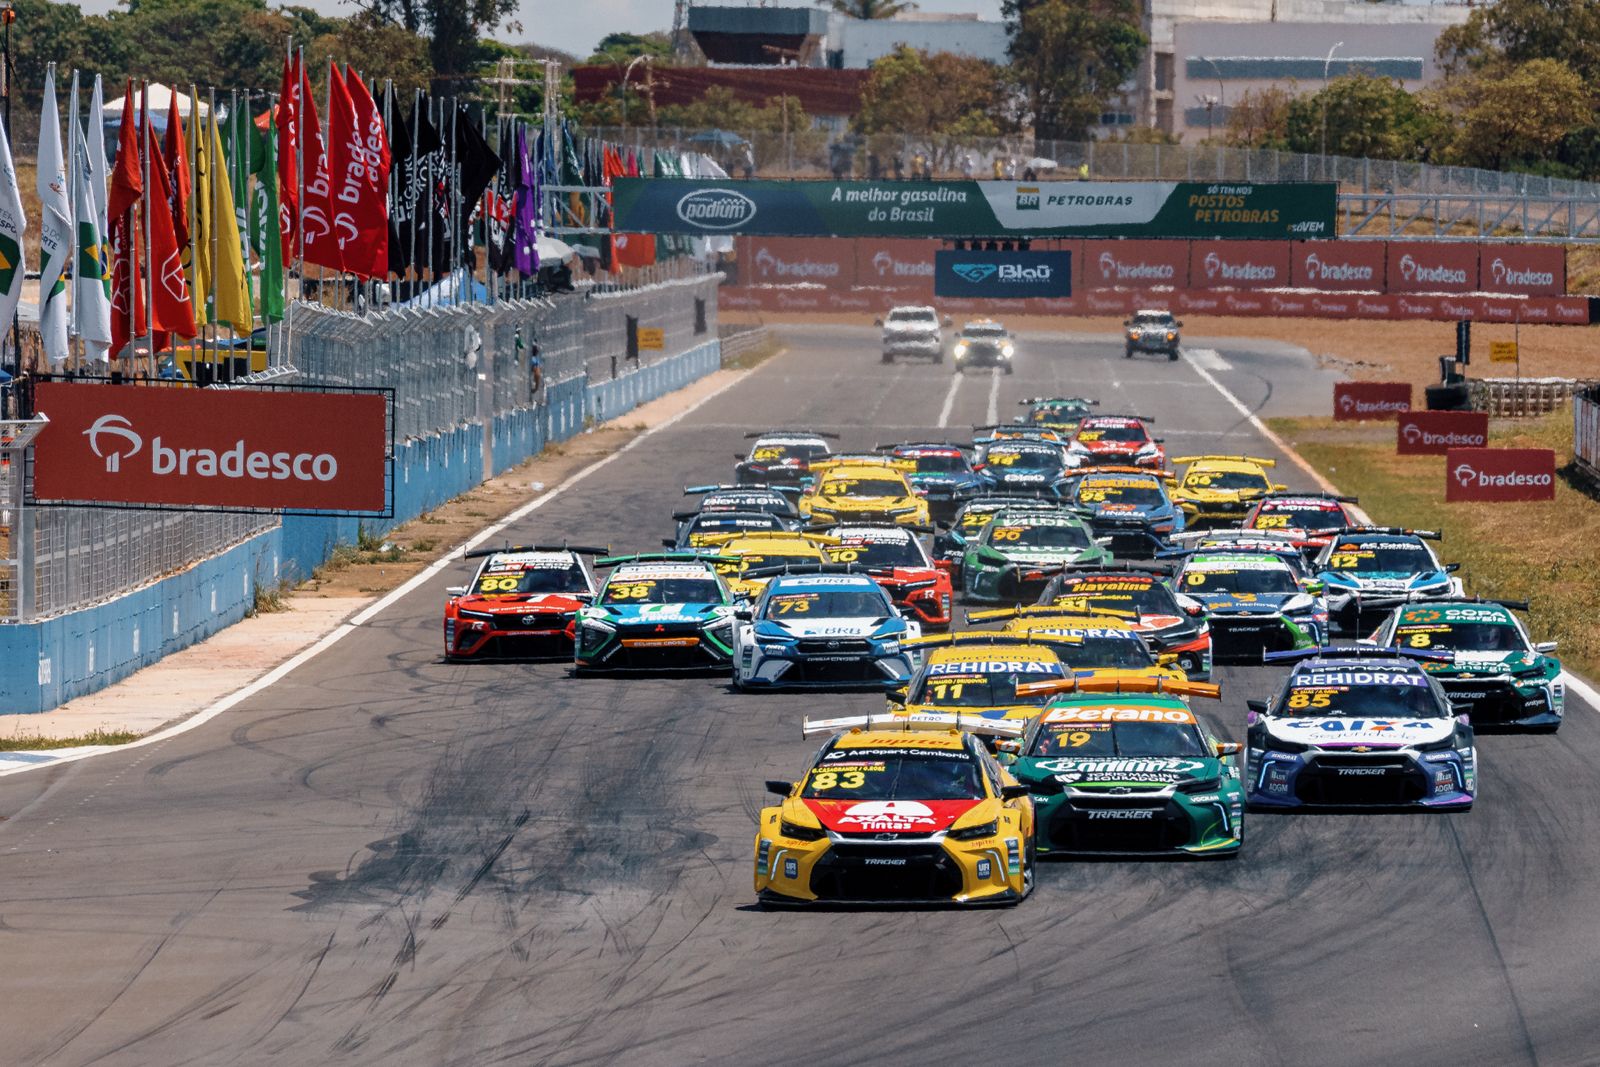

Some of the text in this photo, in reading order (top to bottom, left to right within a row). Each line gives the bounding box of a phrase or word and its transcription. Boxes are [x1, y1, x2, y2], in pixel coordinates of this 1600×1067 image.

[831, 186, 967, 206] A melhor gasolina
[1207, 185, 1253, 194] SÓ TEM NOS
[1047, 195, 1133, 206] PETROBRAS
[1188, 195, 1246, 208] POSTOS
[686, 200, 747, 219] podium
[868, 206, 935, 222] do Brasil
[1194, 209, 1280, 223] PETROBRAS
[1117, 262, 1175, 279] bradesco
[1221, 262, 1276, 280] bradesco
[1320, 262, 1373, 281] bradesco
[1416, 264, 1467, 284] bradesco
[1506, 268, 1553, 285] bradesco
[1355, 399, 1410, 412] bradesco
[1423, 431, 1484, 445] bradesco
[153, 436, 338, 482] bradesco
[1479, 470, 1551, 486] bradesco
[1330, 556, 1359, 568] 12
[480, 578, 518, 591] 80
[1085, 576, 1153, 584] TEXACO
[1187, 574, 1206, 585] 0
[611, 587, 649, 599] 38
[1072, 583, 1151, 593] Havoline
[778, 600, 810, 614] 73
[1445, 609, 1505, 617] COPA
[1446, 615, 1507, 623] energia
[825, 627, 862, 635] BRB
[1409, 633, 1431, 648] 8
[930, 661, 1056, 675] REHIDRAT
[1296, 673, 1423, 686] REHIDRAT
[934, 684, 963, 699] 11
[1288, 693, 1331, 708] 85
[1044, 707, 1190, 722] Betano
[1286, 720, 1434, 732] CAIXA
[1056, 732, 1091, 748] 19
[848, 749, 909, 757] Aeropark
[1338, 768, 1386, 776] TRACKER
[811, 771, 866, 790] 83
[837, 815, 936, 825] AXALTA
[1088, 810, 1153, 819] TRACKER
[861, 821, 912, 830] Tintas
